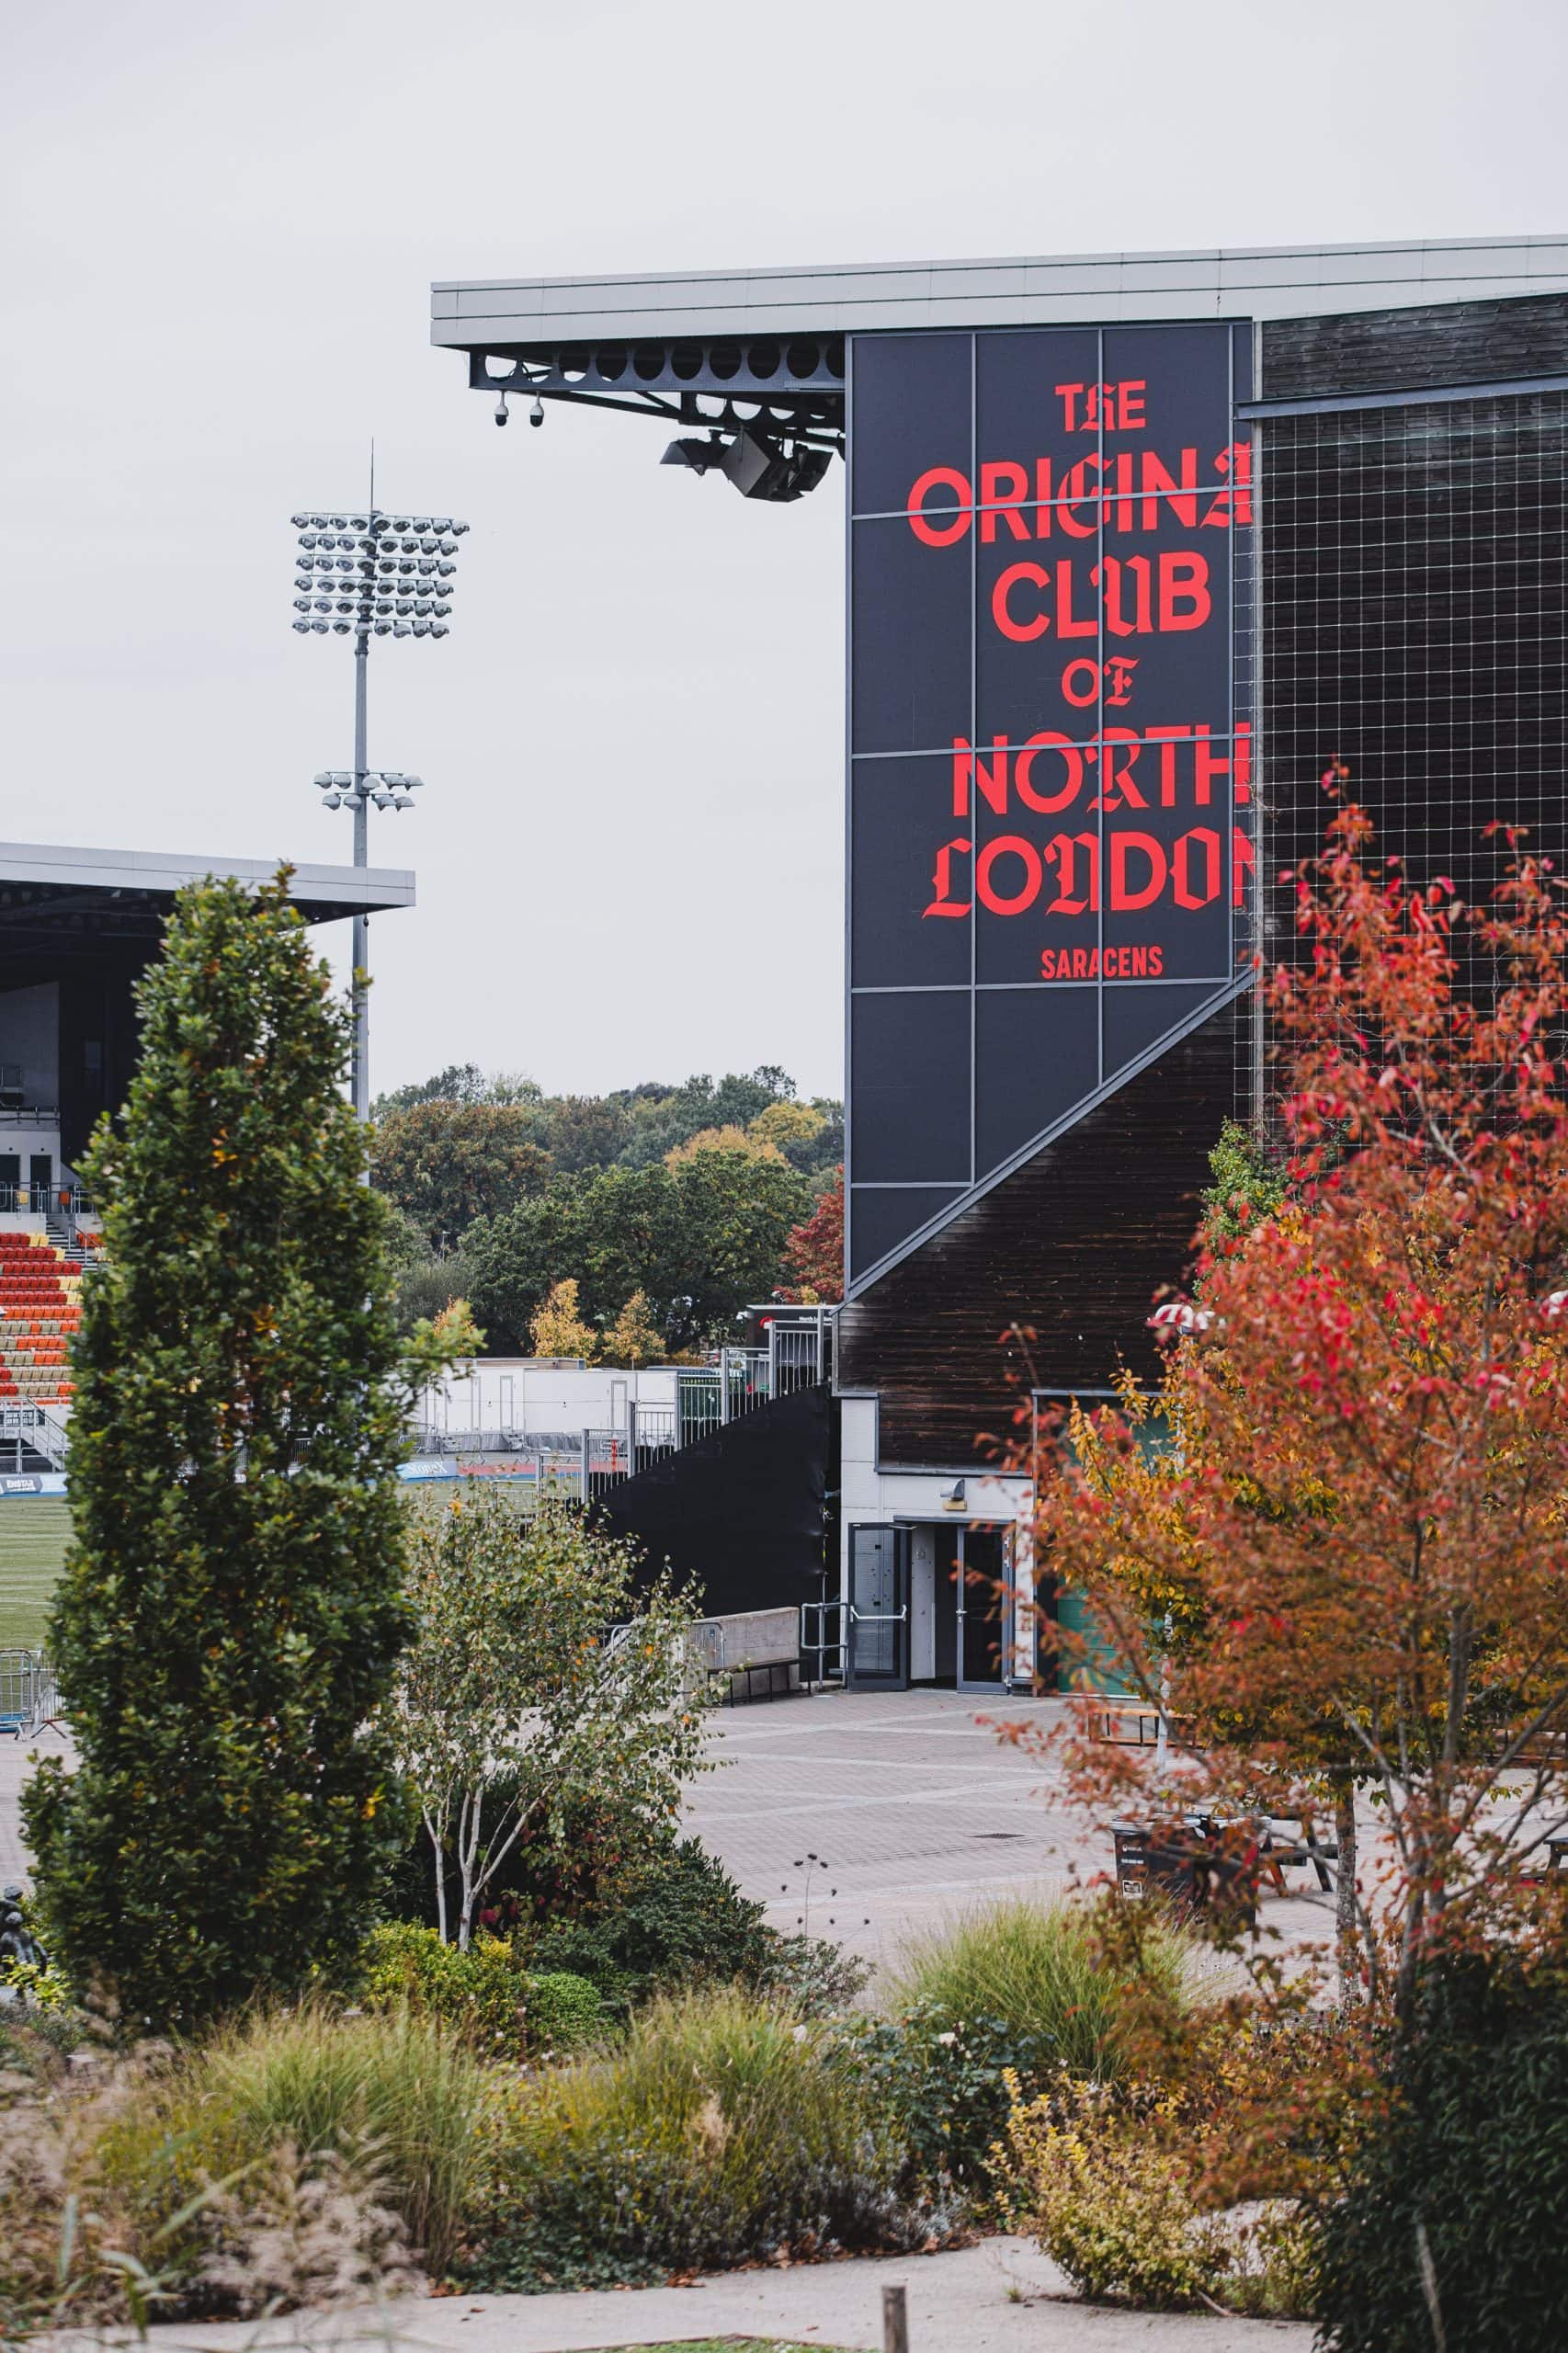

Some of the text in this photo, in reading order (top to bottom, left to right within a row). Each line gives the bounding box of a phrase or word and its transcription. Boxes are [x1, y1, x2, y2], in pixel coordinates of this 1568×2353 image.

[1055, 381, 1146, 432] THE
[992, 551, 1211, 642] CLUB
[1062, 656, 1140, 707] OF
[953, 722, 1251, 816] NORTH
[1041, 945, 1163, 979] SARACENS
